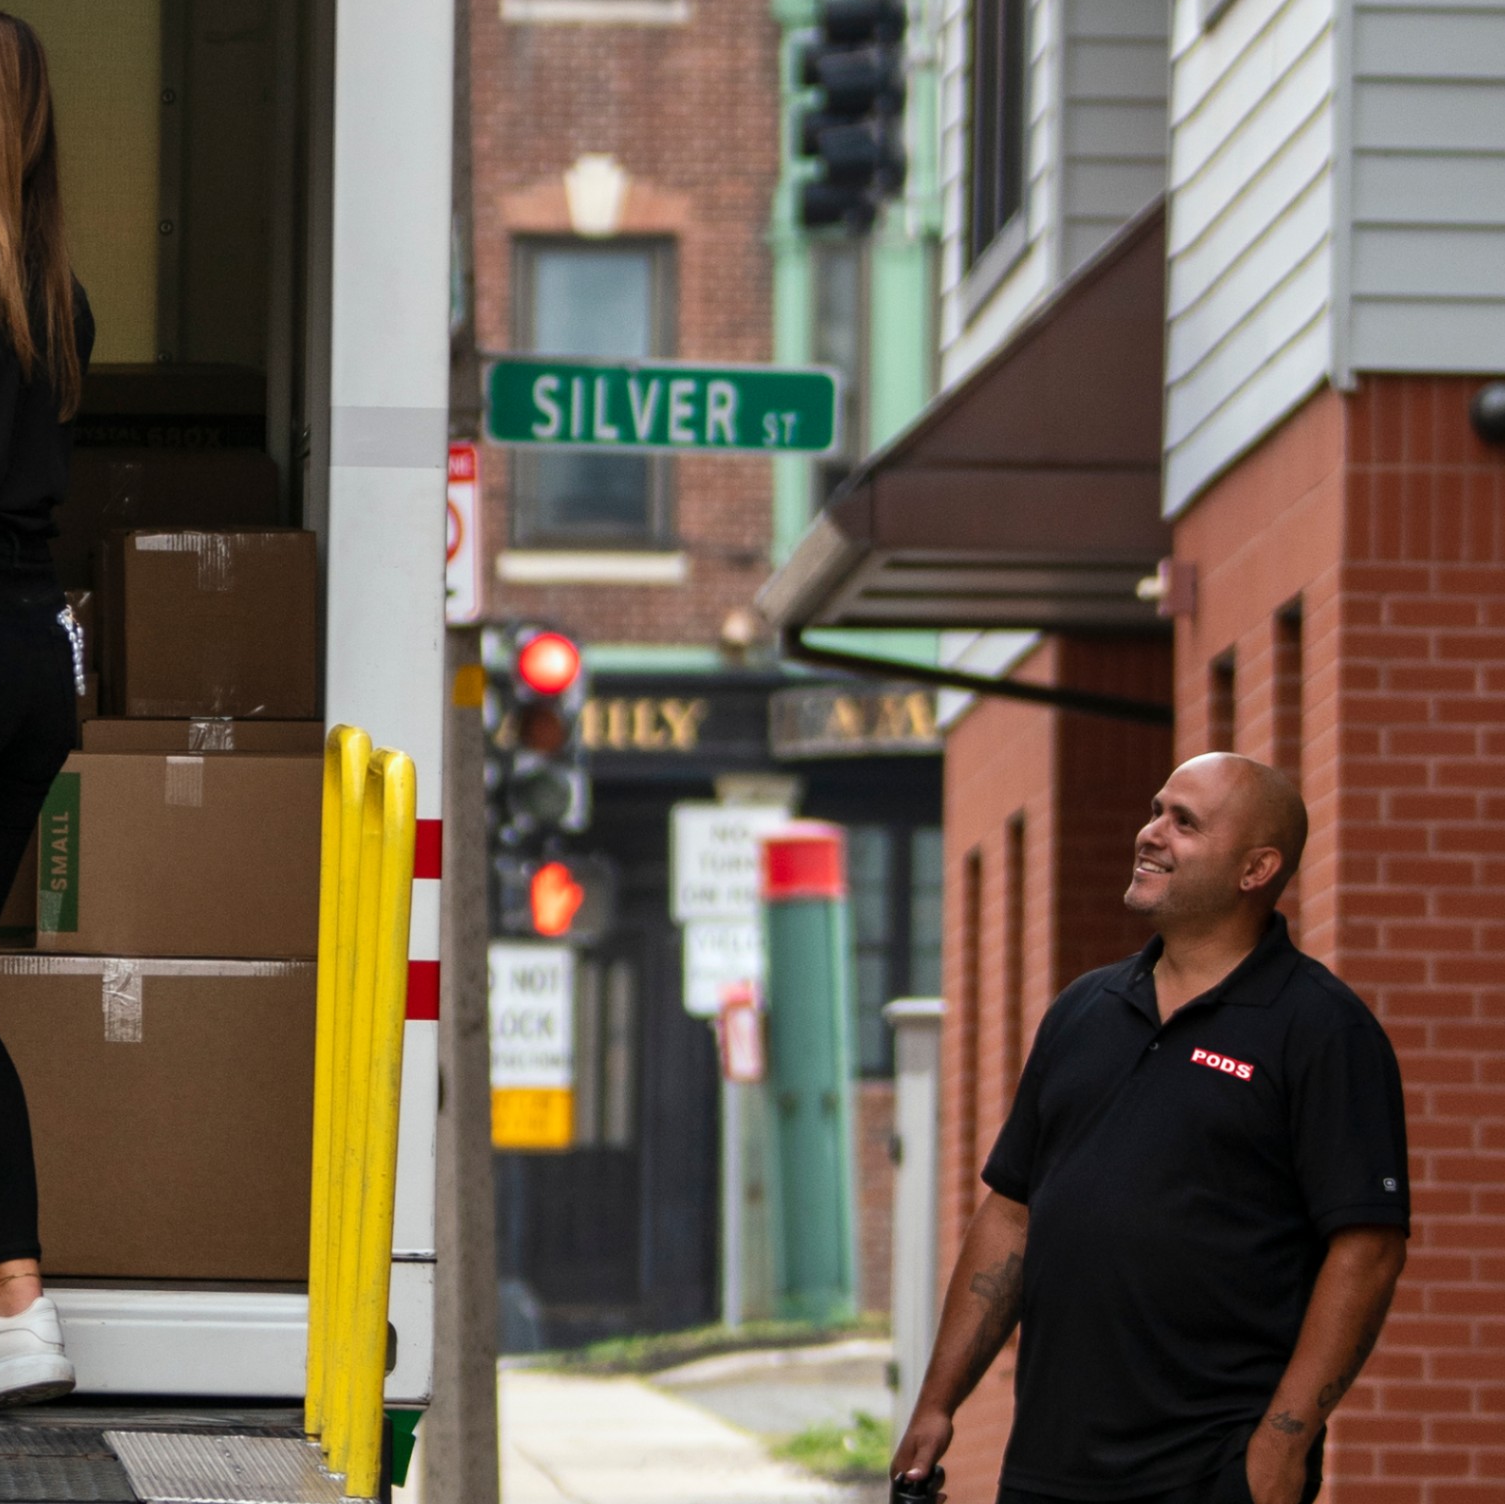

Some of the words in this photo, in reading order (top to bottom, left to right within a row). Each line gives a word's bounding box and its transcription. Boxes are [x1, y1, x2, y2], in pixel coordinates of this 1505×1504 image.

[532, 374, 739, 444] SILVER
[762, 411, 799, 445] ST
[50, 811, 70, 891] SMALL
[510, 965, 560, 995] NOT
[497, 1009, 555, 1041] OCK
[1191, 1048, 1253, 1080] PODS
